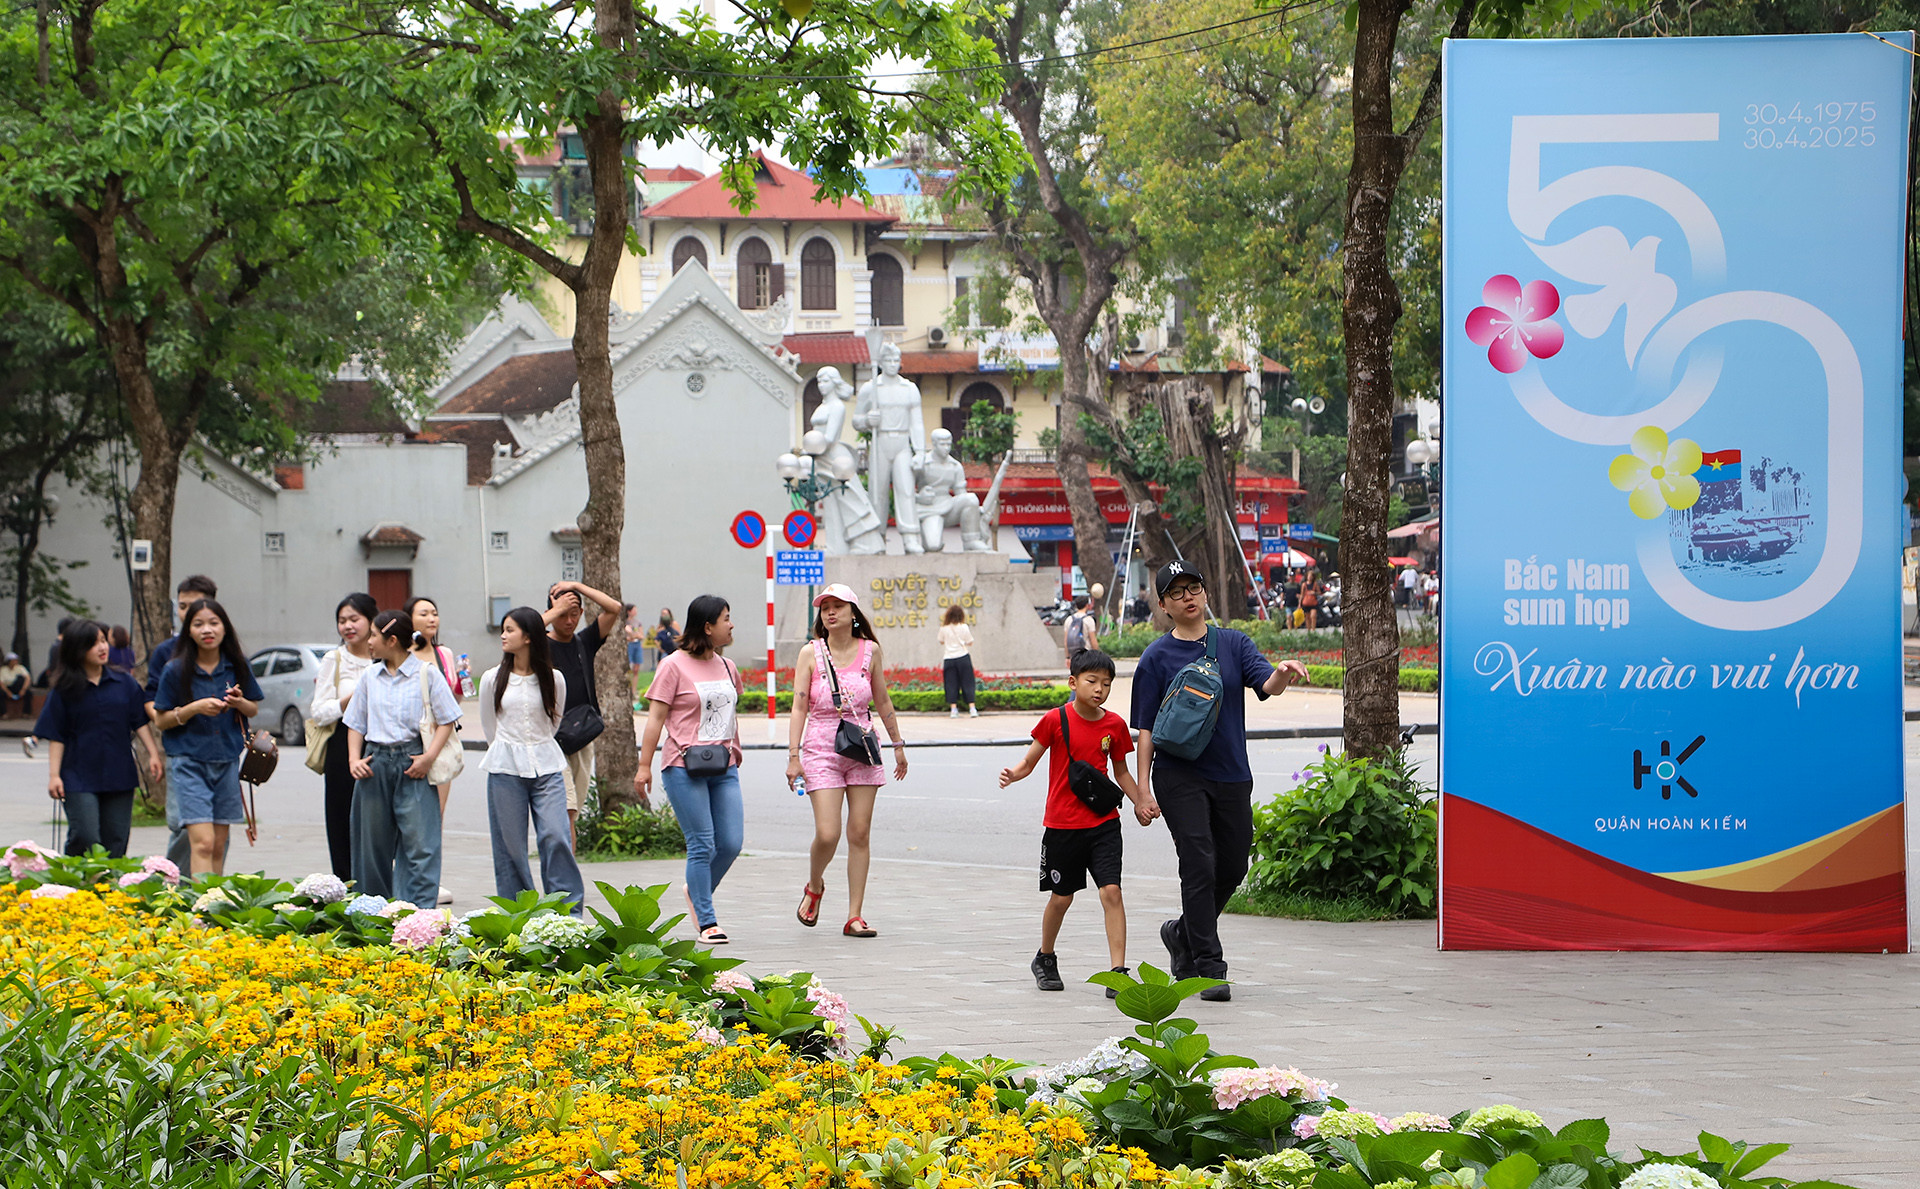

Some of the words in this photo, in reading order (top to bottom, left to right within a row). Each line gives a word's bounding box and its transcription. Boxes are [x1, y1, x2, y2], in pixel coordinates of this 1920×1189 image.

[1743, 101, 1877, 125] 30.4.1975
[1743, 126, 1876, 149] 30.4.2025
[1016, 503, 1044, 513] THÔNG
[1045, 504, 1066, 512] MINH
[871, 573, 927, 591] QUYẾT
[1504, 554, 1558, 591] Bắc
[1567, 558, 1630, 591] Nam
[937, 591, 983, 608] QUỐC
[873, 610, 928, 628] QUYẾT
[1503, 598, 1566, 626] sum
[1575, 593, 1630, 631] họp
[1473, 641, 1608, 697] Xuân
[1619, 657, 1697, 690] nào
[1710, 653, 1777, 690] vui
[1785, 645, 1860, 710] hơn
[1594, 815, 1641, 833] QUẬN
[1647, 815, 1694, 830] HOÀN
